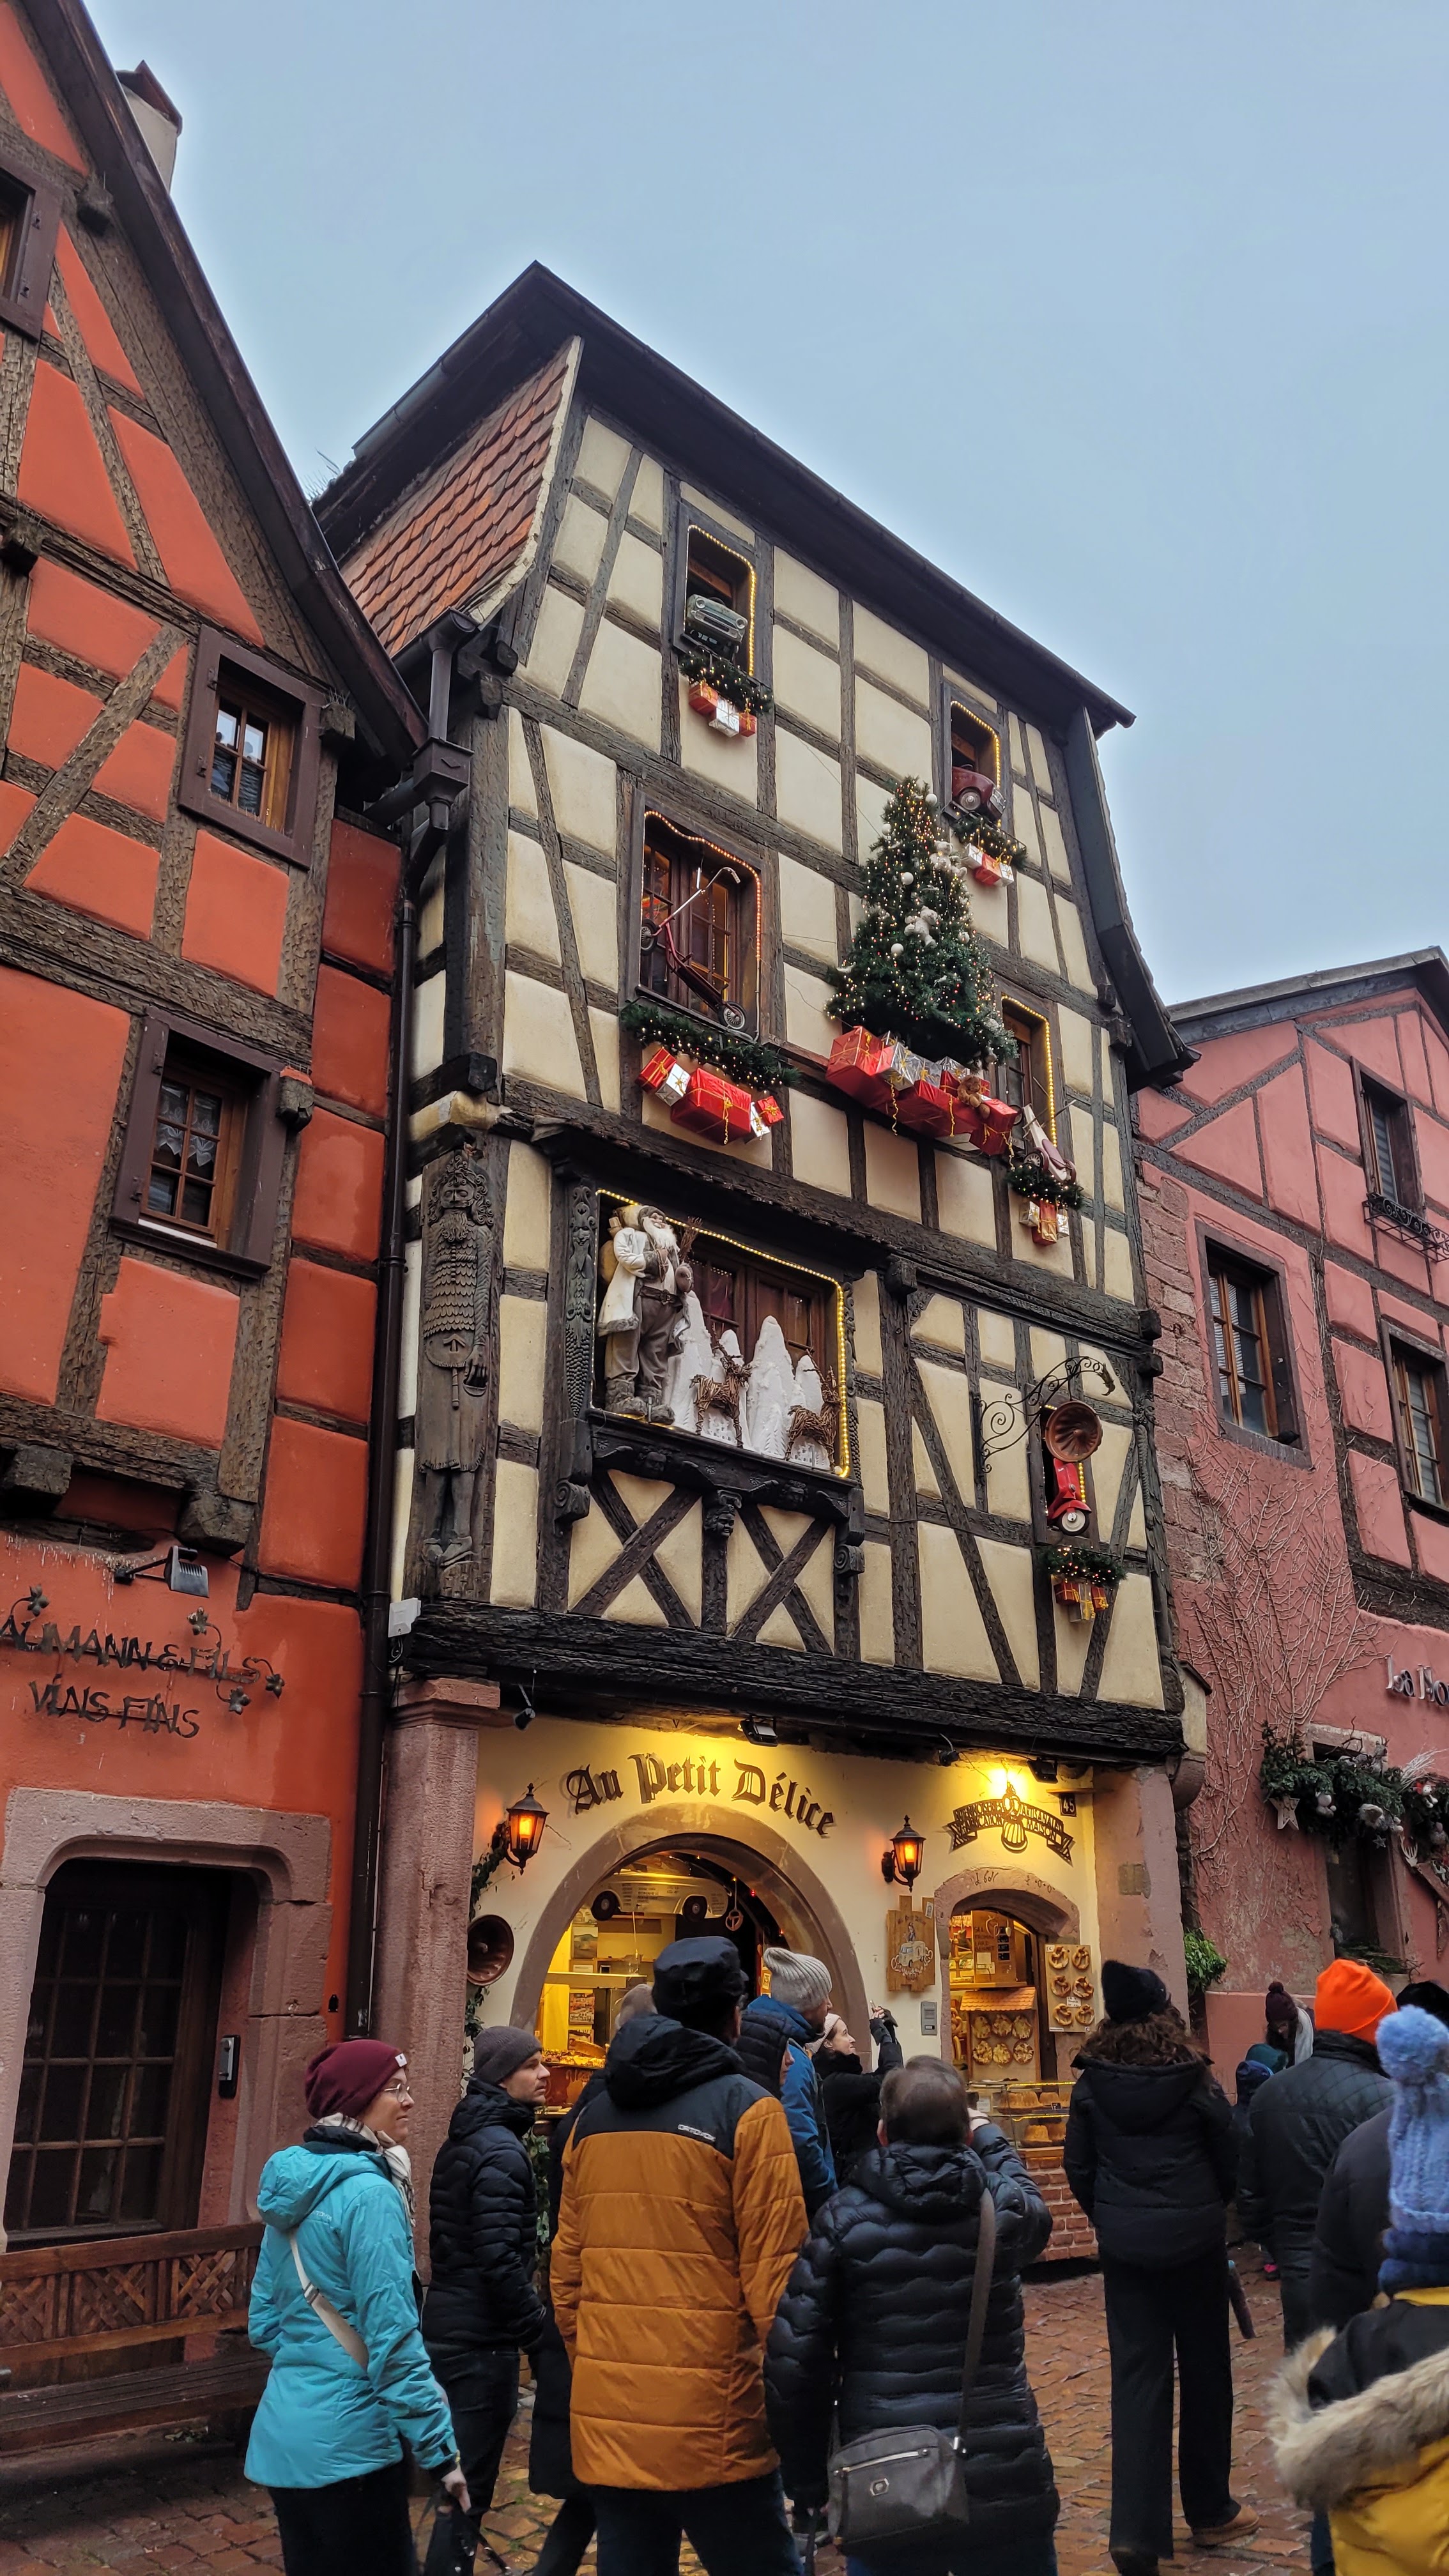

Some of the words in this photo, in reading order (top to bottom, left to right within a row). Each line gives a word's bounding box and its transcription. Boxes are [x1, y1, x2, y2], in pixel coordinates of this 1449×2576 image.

[187, 1642, 261, 1683] FILS
[1385, 1653, 1416, 1697] La
[29, 1673, 110, 1722] VINS
[118, 1693, 200, 1738] FINS
[566, 1763, 624, 1815] Au
[627, 1752, 721, 1804] Petit
[731, 1758, 836, 1836] Délice
[1063, 1795, 1075, 1813] 45
[1026, 1818, 1056, 1841] MAISON
[677, 2124, 716, 2142] ORTOVOX
